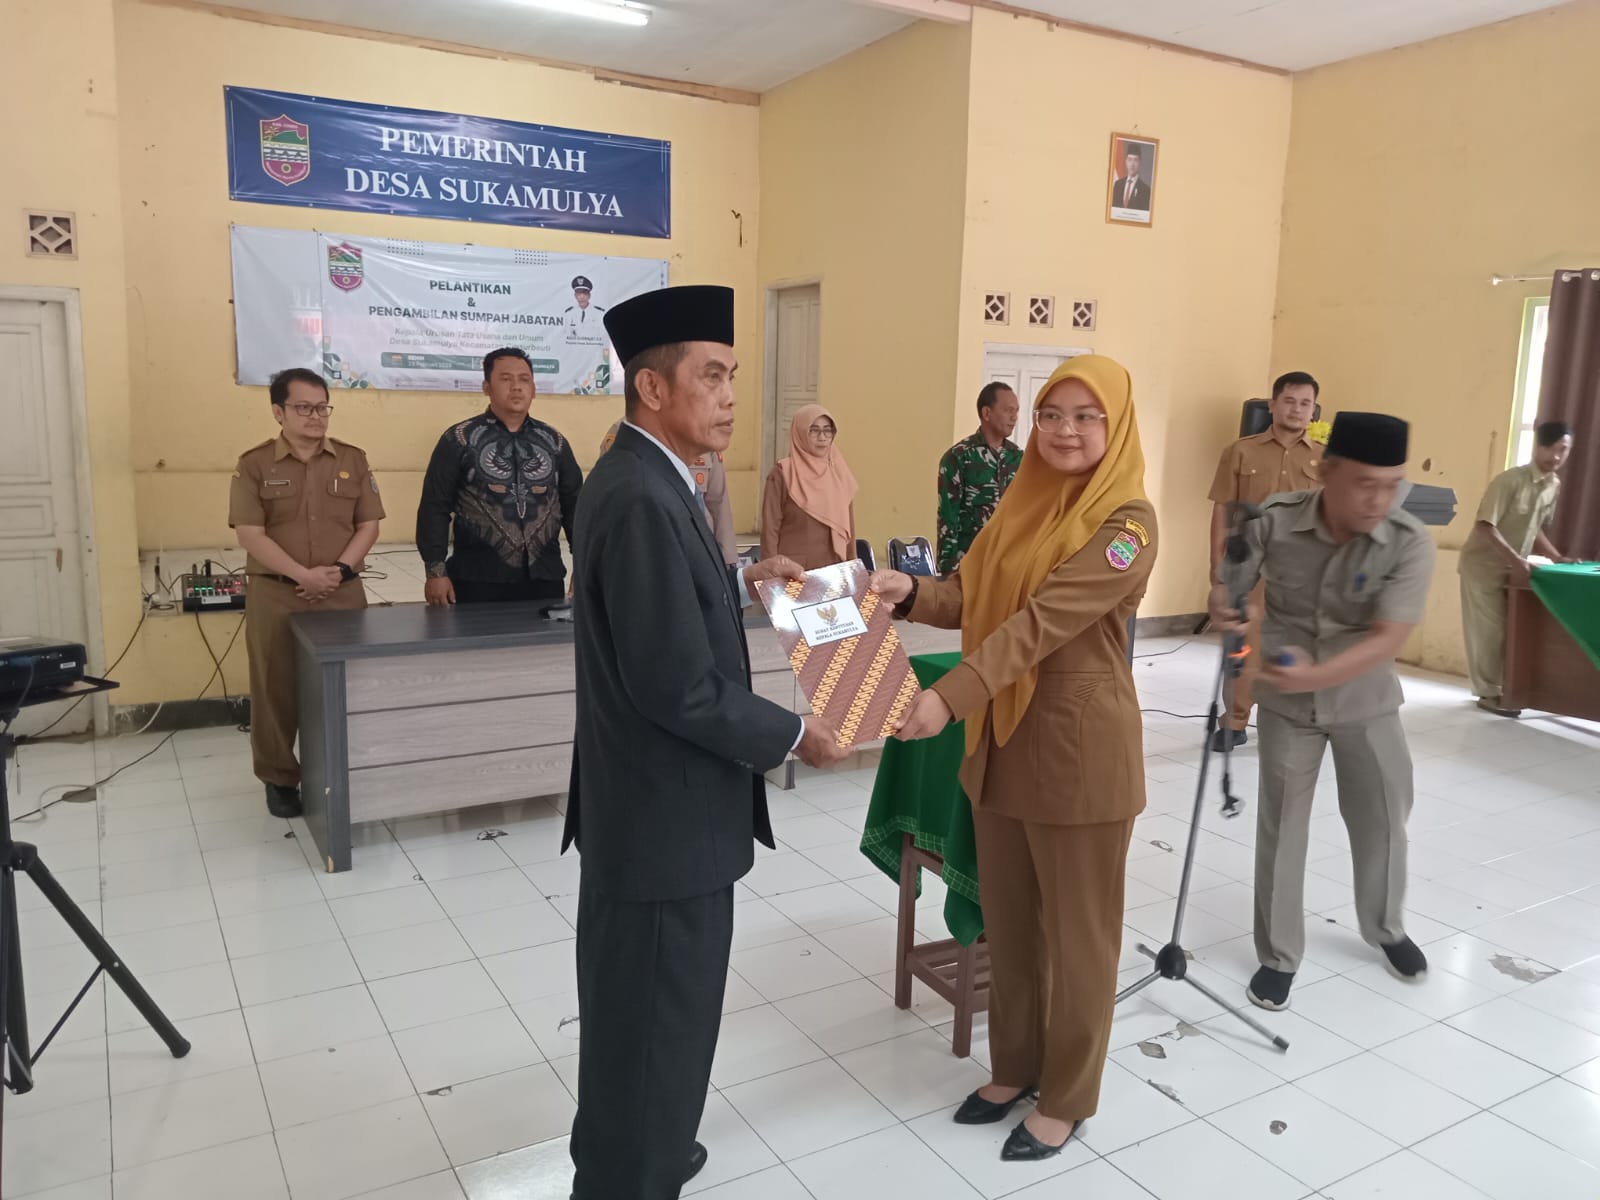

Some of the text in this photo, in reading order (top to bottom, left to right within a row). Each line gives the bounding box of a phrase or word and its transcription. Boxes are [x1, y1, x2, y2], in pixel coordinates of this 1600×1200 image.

[379, 126, 587, 173] PEMERINTAH
[344, 167, 433, 200] DESA
[439, 177, 625, 218] SUKAMULYA
[429, 280, 511, 295] PELANTIKAN
[467, 297, 476, 307] &
[368, 305, 564, 326] PENGAMBILAN SUMPAH JABATAN
[389, 337, 410, 345] Desa
